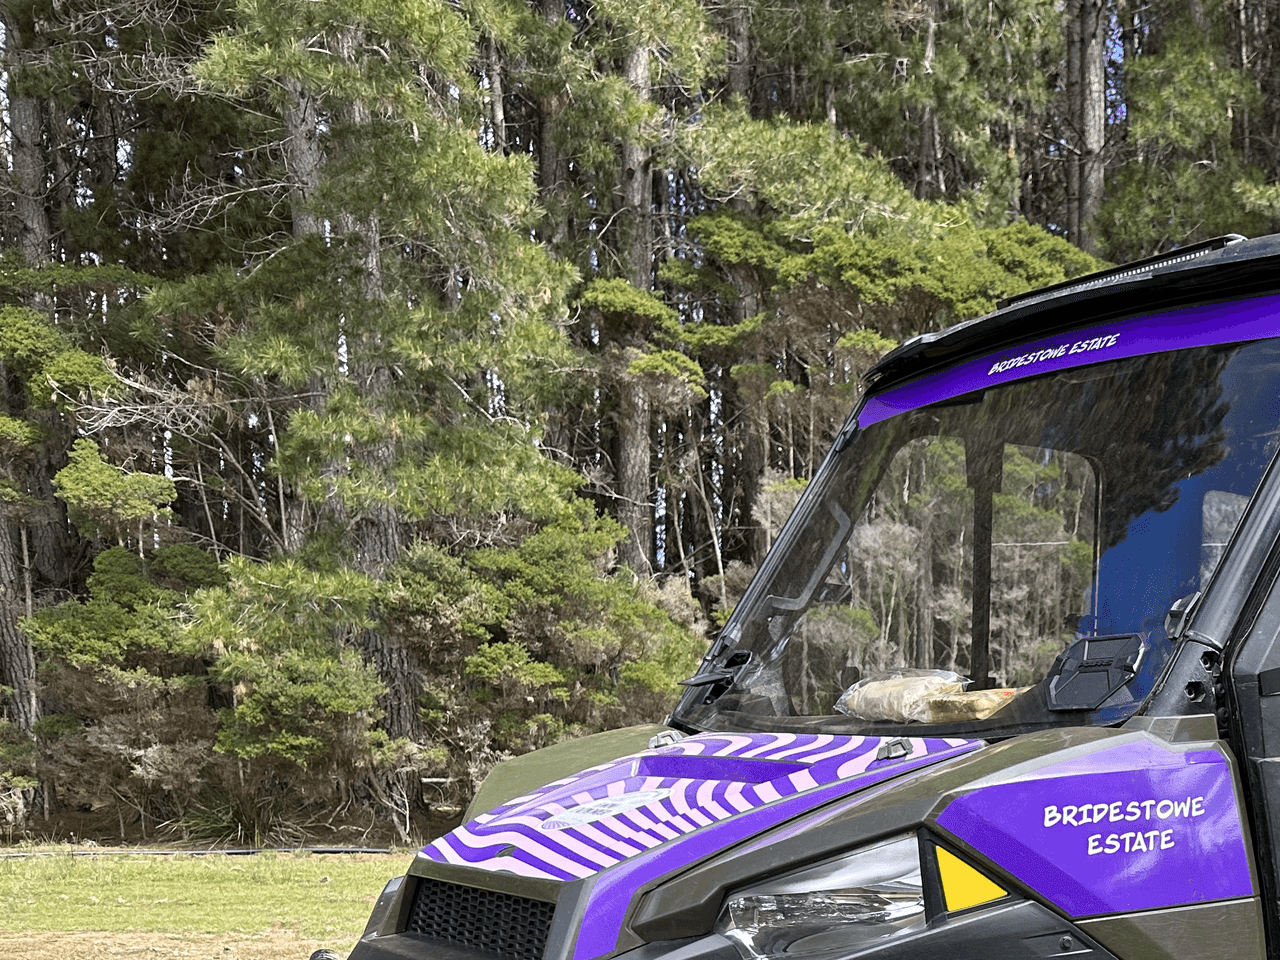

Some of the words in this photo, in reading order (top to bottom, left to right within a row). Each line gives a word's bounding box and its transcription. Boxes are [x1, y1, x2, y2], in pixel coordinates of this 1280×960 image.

[987, 344, 1070, 376] BRIDESTOWE
[1068, 333, 1121, 355] ESTATE
[1043, 796, 1206, 827] BRIDESTOWE
[1087, 828, 1176, 856] ESTATE
